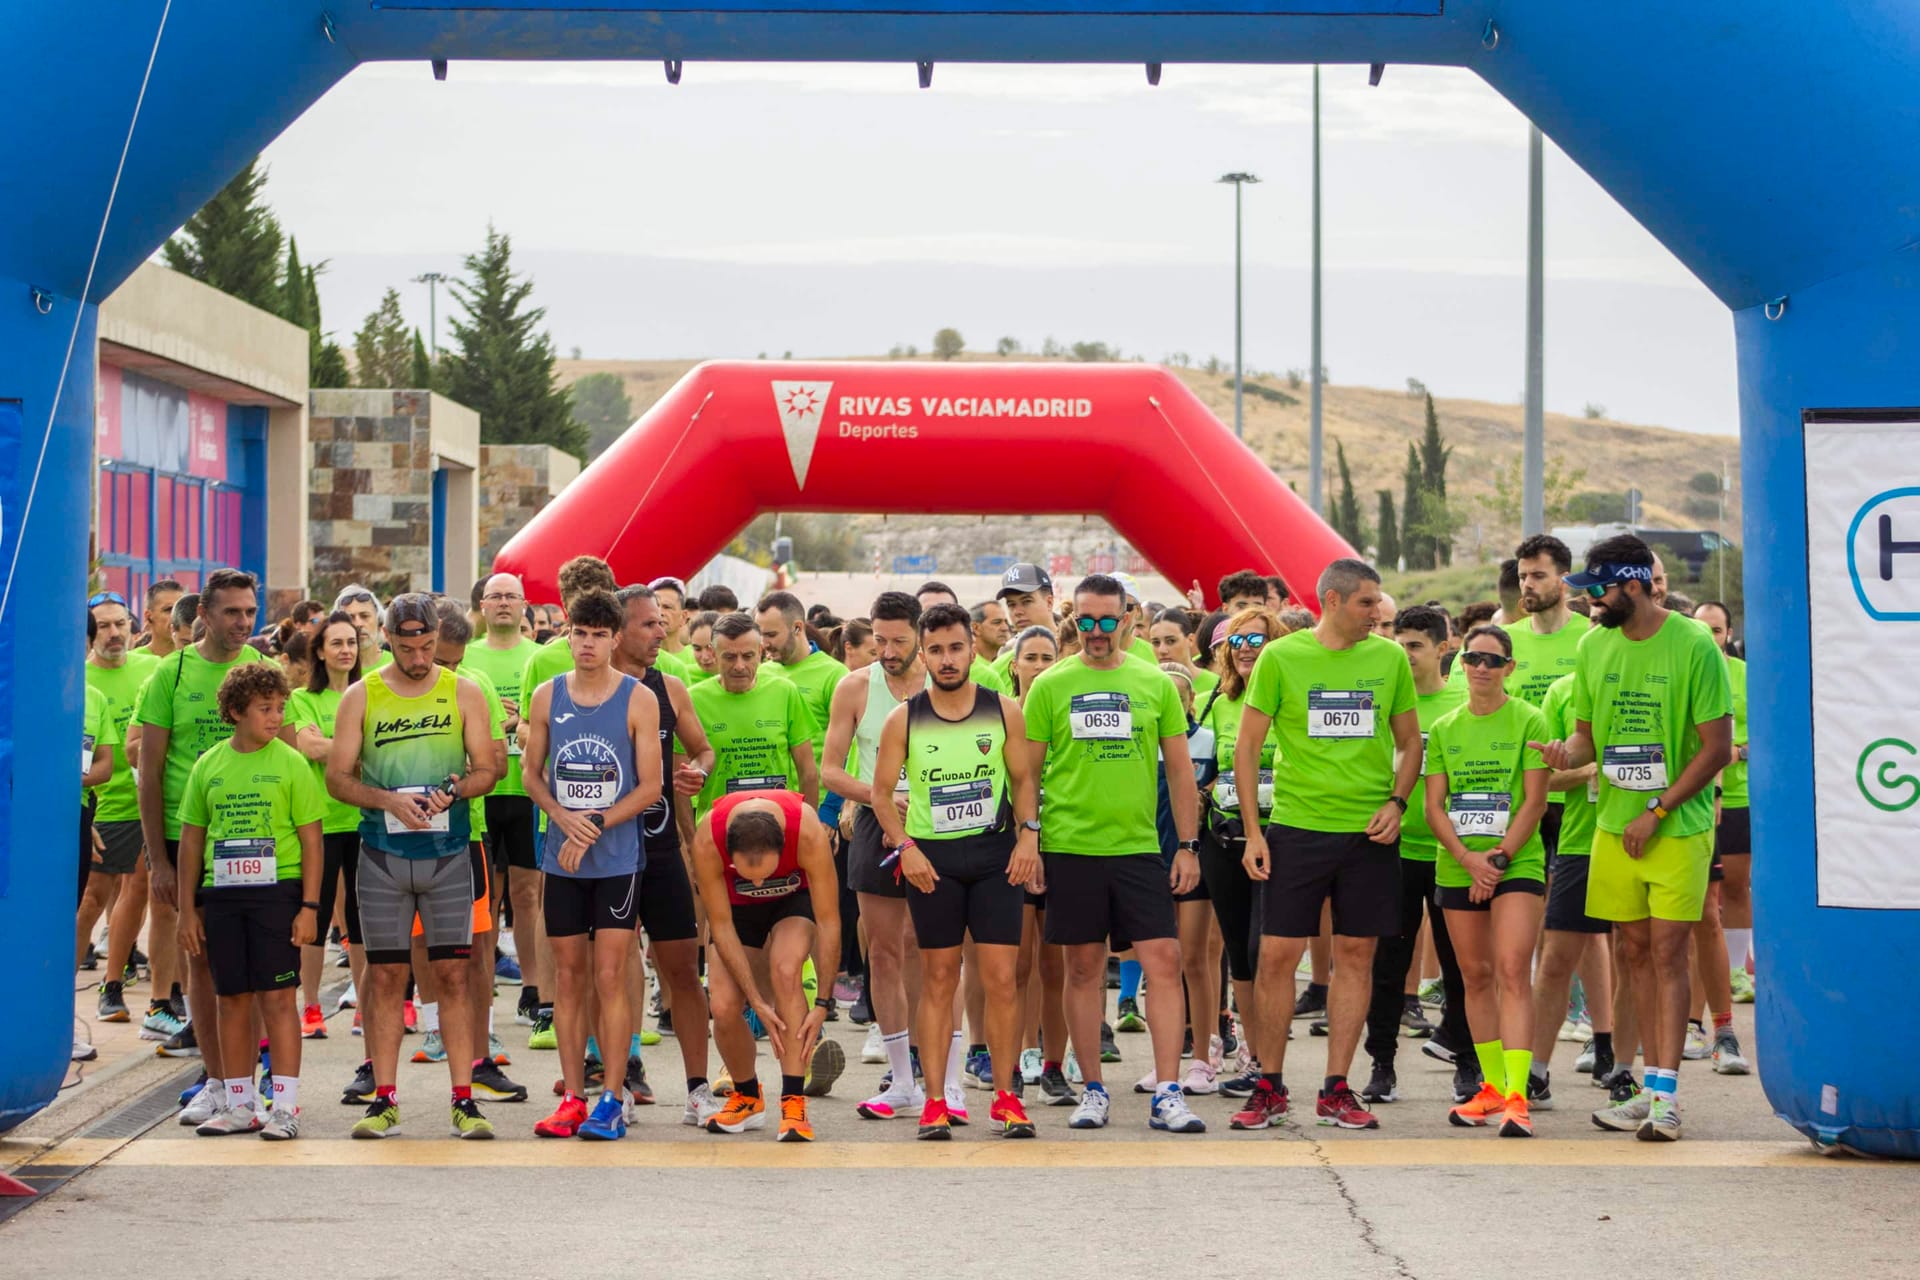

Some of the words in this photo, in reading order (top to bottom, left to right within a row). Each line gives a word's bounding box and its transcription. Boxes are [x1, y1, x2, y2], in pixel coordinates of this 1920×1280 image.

[839, 397, 912, 416] RIVAS
[921, 397, 1092, 418] VACIAMADRID
[839, 422, 918, 441] Deportes
[1084, 713, 1120, 728] 0639
[1324, 712, 1360, 726] 0670
[929, 768, 972, 782] CIUDAD
[1618, 766, 1652, 781] 0735
[568, 784, 602, 798] 0823
[232, 800, 272, 809] Vaciamadrid
[946, 802, 982, 820] 0740
[1460, 812, 1494, 826] 0736
[226, 860, 262, 876] 1169
